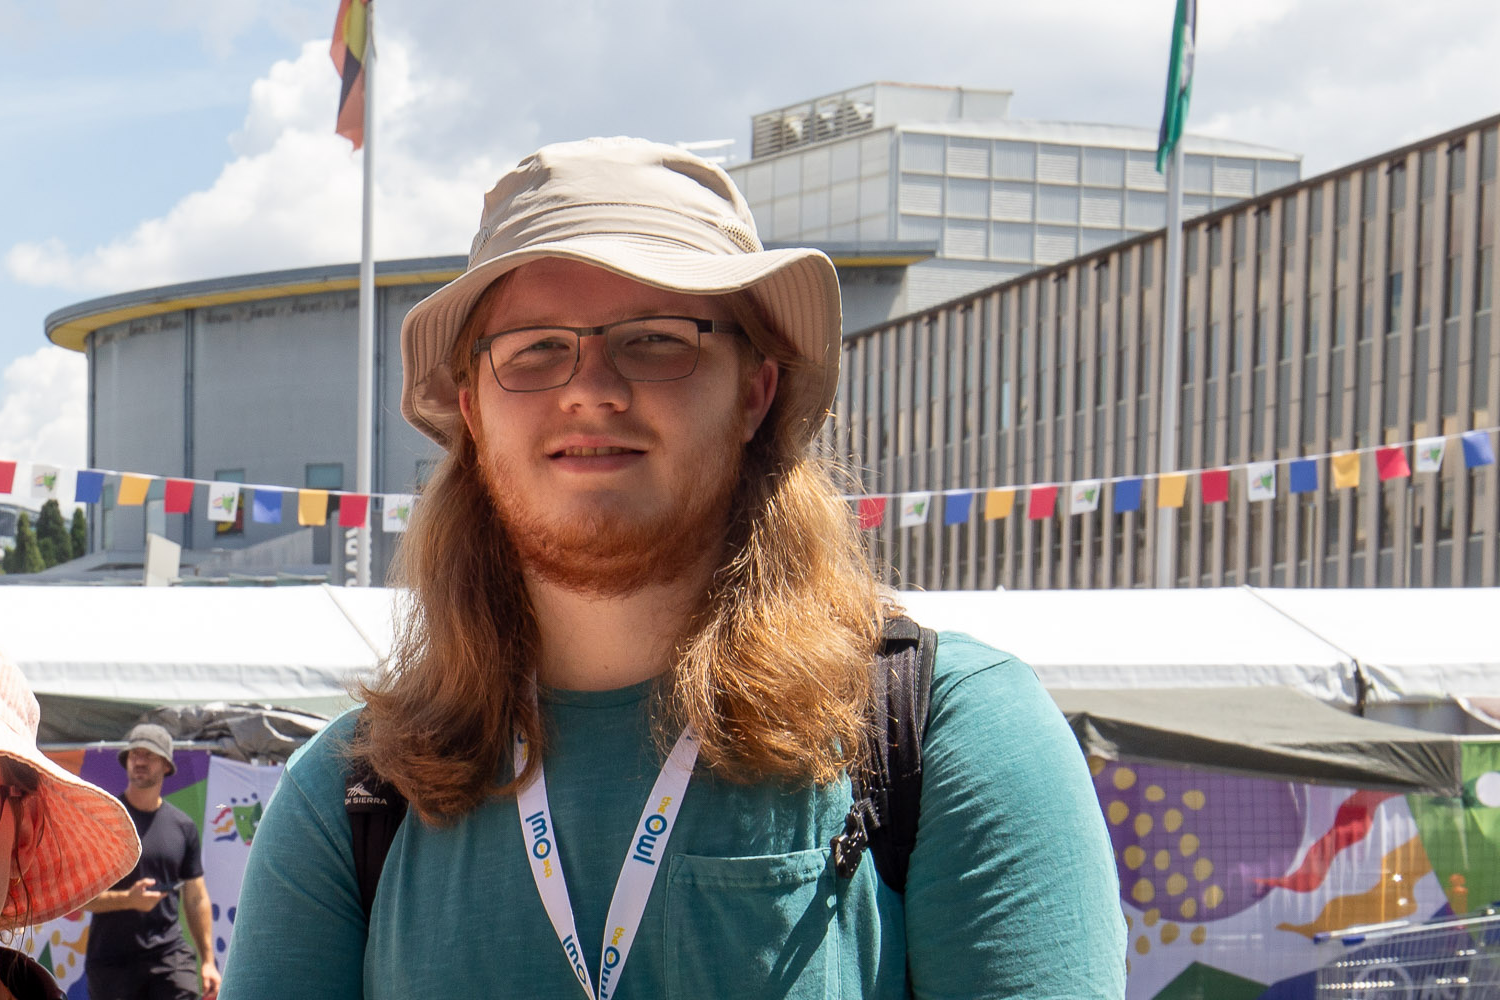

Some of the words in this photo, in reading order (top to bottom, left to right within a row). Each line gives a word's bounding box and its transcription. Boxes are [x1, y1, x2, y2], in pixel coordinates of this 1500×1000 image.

[352, 796, 388, 805] SIERRA
[657, 796, 672, 814] the
[525, 810, 551, 860] Owl
[633, 814, 667, 865] Owl
[562, 934, 587, 985] Owl
[611, 926, 625, 947] the
[600, 946, 620, 999] Owl
